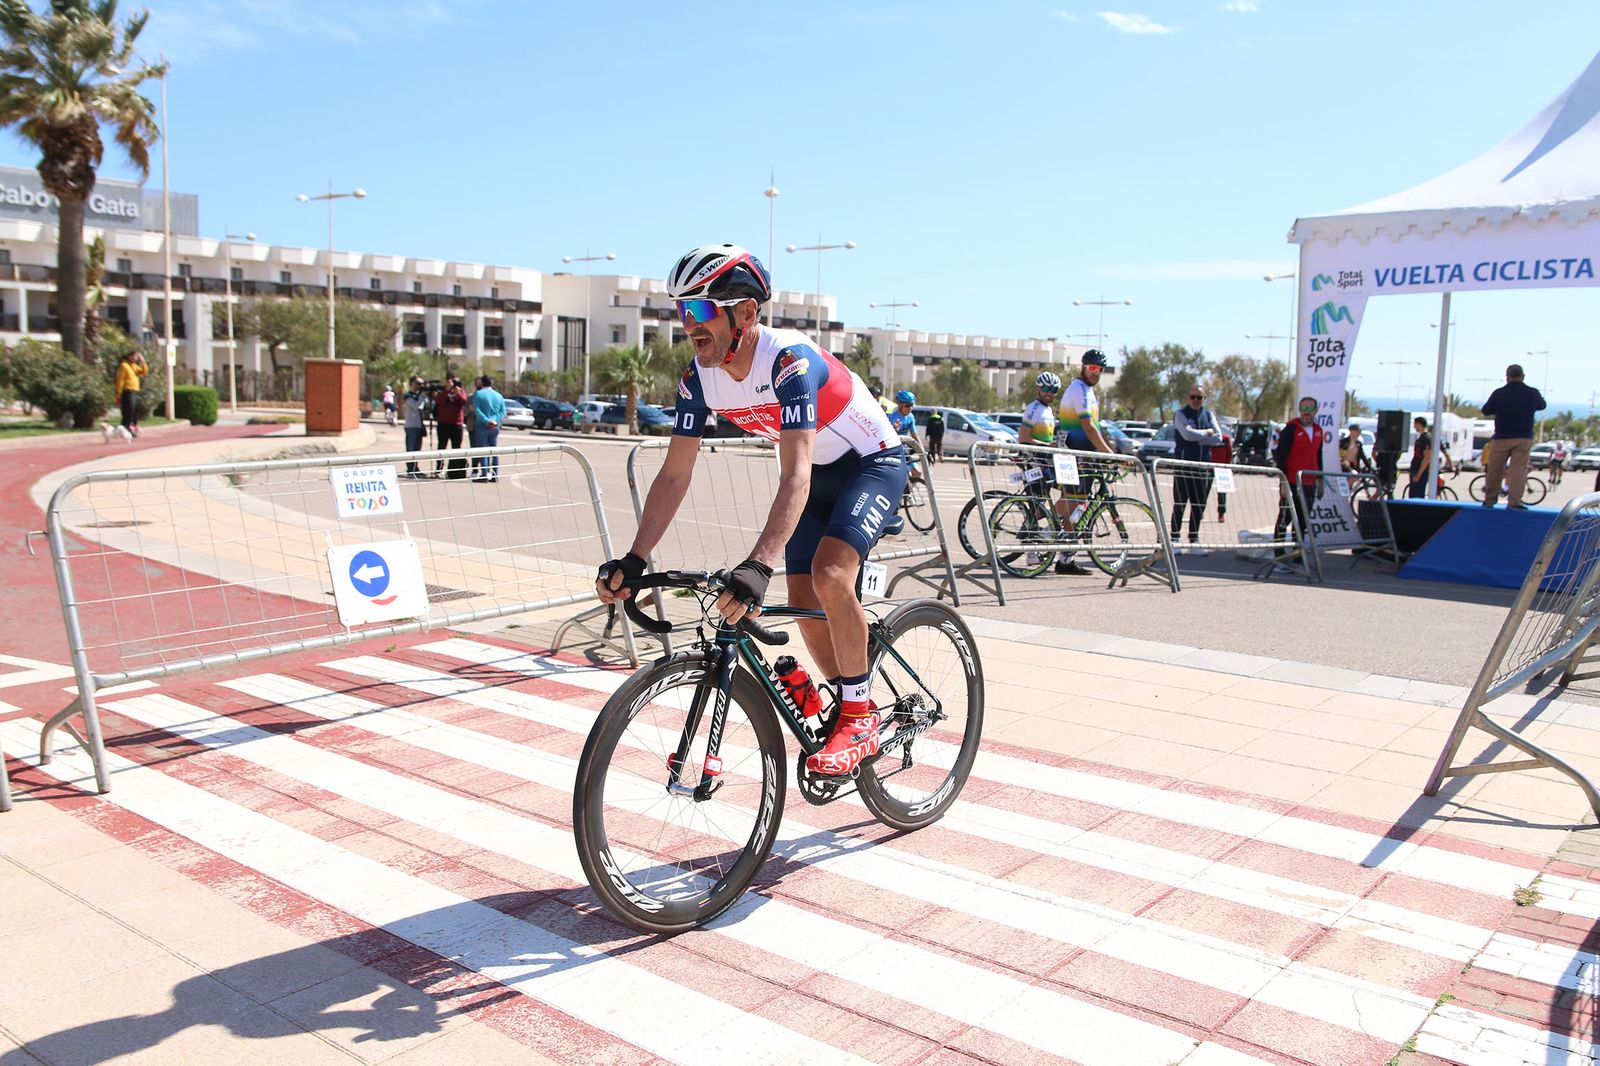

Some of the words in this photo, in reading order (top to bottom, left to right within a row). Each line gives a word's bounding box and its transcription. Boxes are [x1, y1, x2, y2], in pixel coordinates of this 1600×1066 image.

[89, 193, 140, 218] Gata
[1338, 270, 1363, 279] Total
[1374, 264, 1465, 287] VUELTA
[1472, 258, 1594, 281] CICLISTA
[1337, 279, 1363, 289] Sport
[1309, 337, 1346, 353] Tota
[343, 469, 383, 478] GRUPO
[345, 480, 387, 494] RENTA
[347, 495, 389, 511] TODO
[851, 491, 870, 517] BICICLETAS
[1308, 504, 1342, 520] otal
[860, 506, 884, 539] KM
[1311, 518, 1349, 538] port
[867, 574, 878, 591] 11
[708, 688, 727, 757] ECIALIZED
